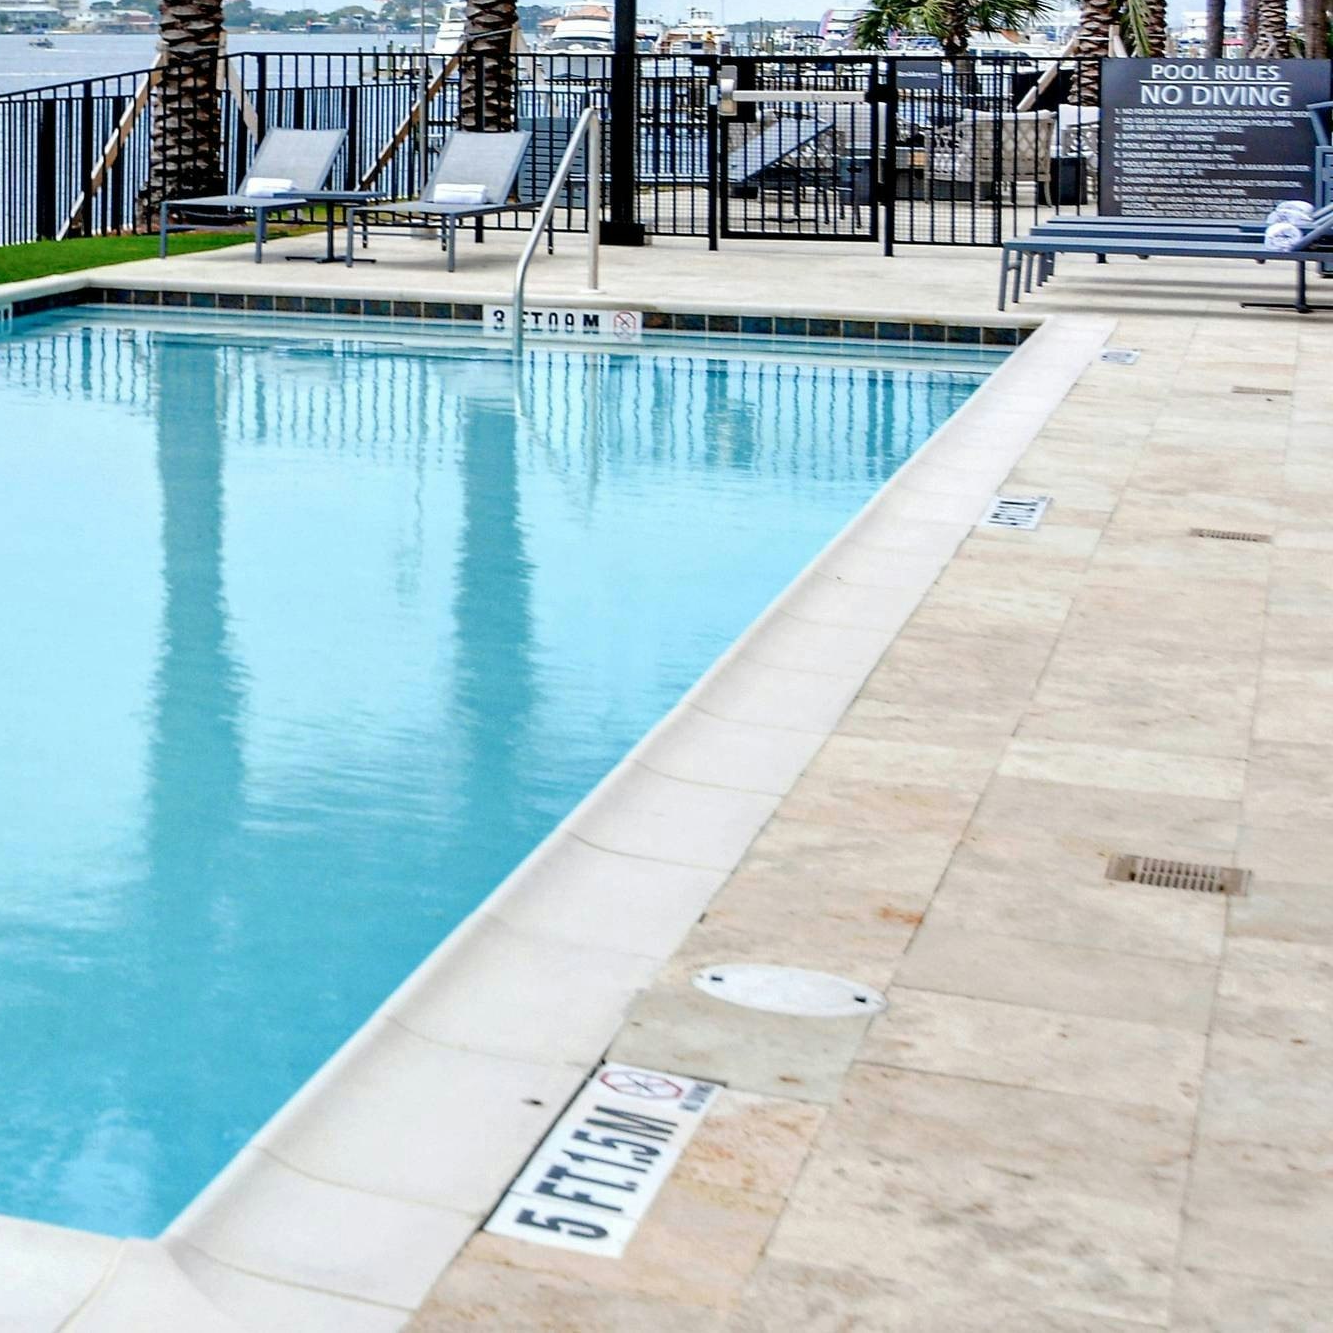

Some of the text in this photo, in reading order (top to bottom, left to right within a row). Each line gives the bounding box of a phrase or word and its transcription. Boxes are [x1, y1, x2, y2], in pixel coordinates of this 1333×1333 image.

[1151, 64, 1281, 81] POOL RULES
[1140, 84, 1293, 107] NO DIVING
[515, 1208, 609, 1241] 5
[584, 1104, 679, 1143] M
